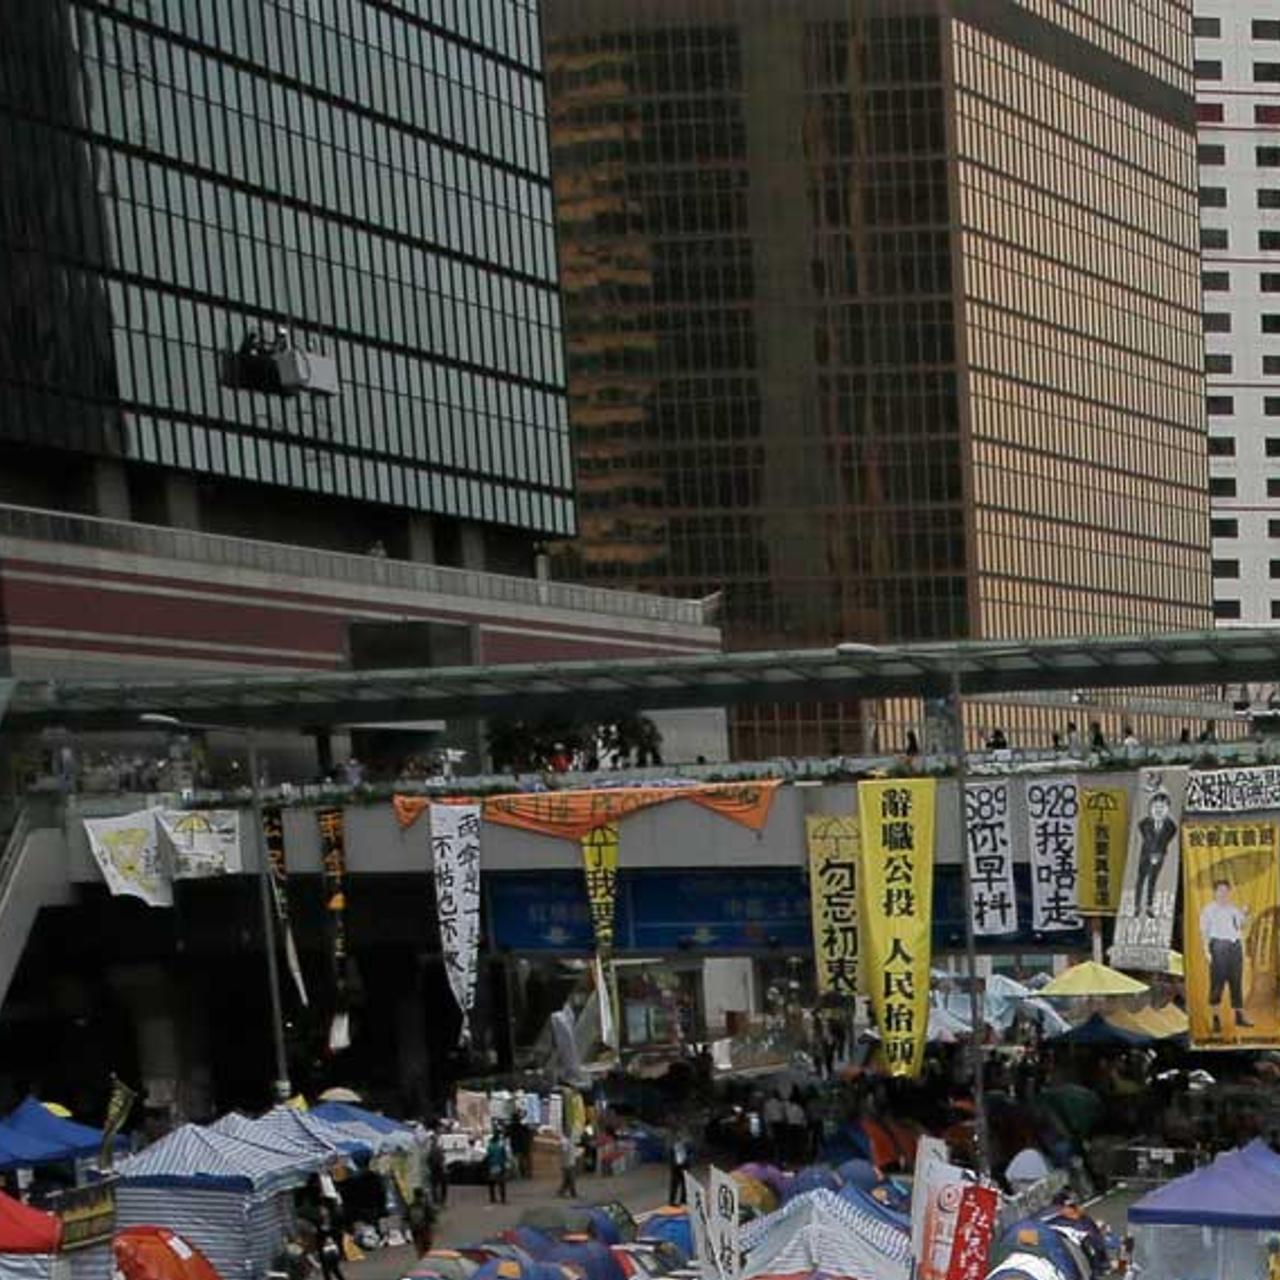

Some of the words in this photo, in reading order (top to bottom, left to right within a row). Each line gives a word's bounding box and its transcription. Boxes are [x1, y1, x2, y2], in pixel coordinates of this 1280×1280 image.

[881, 789, 914, 917] 辭職公投
[818, 857, 859, 994] 勿忘初衷
[882, 938, 916, 1066] 人民抬頭
